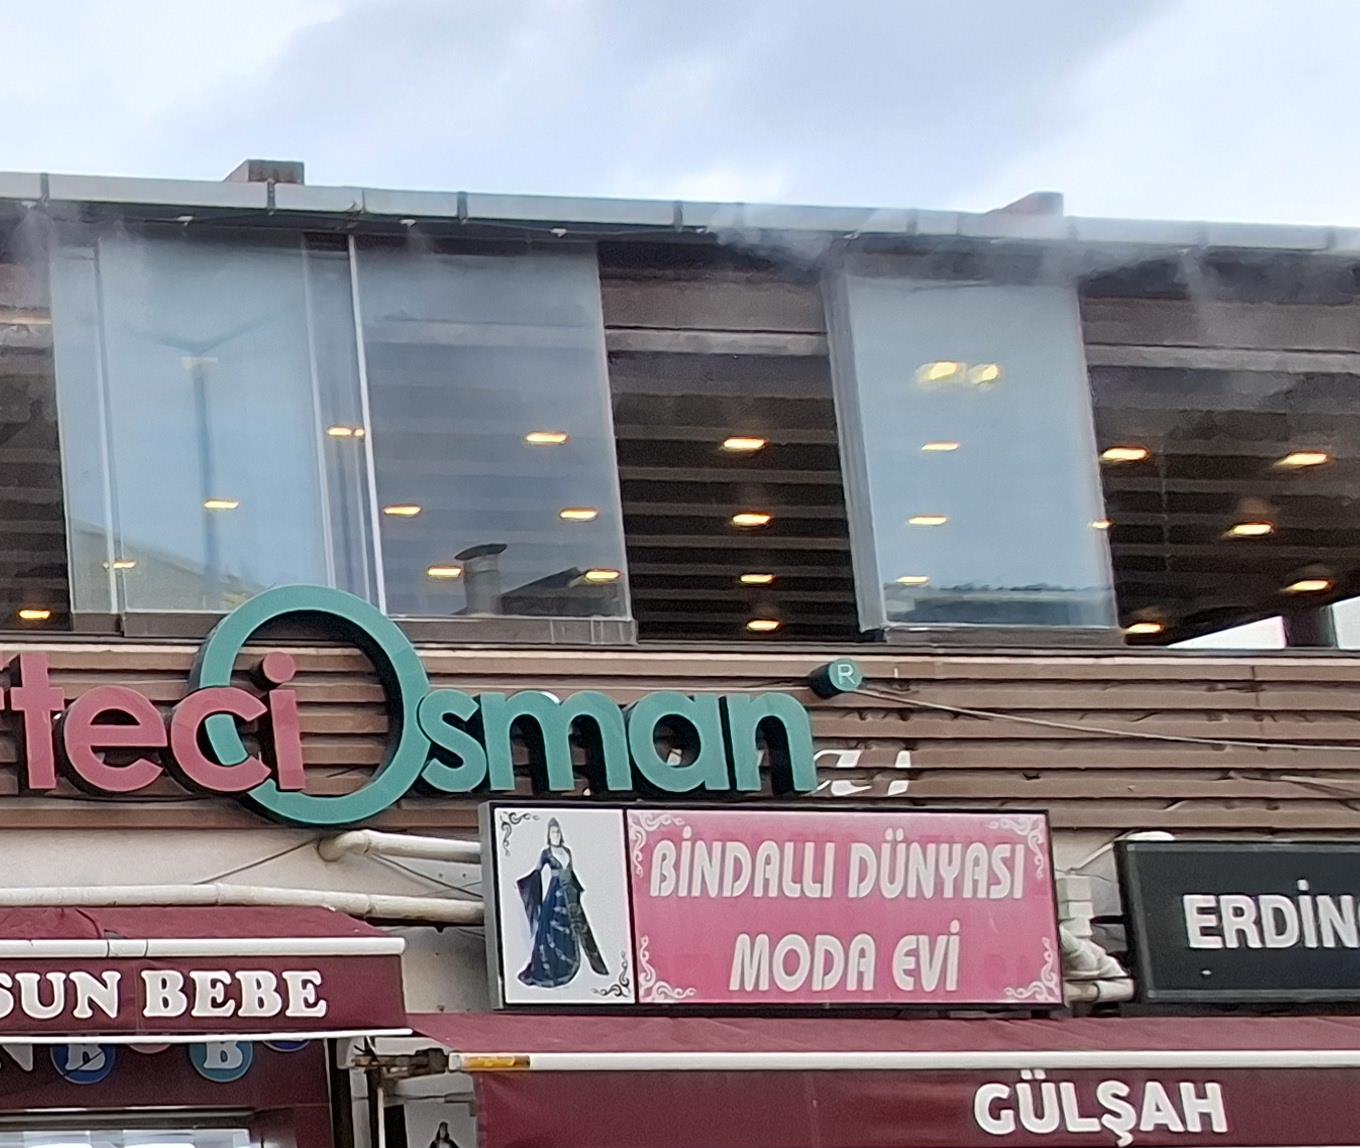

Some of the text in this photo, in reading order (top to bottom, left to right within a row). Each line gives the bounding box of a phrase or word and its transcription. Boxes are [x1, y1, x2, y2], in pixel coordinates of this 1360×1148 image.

[649, 825, 1025, 899] BİNDALLI DÜNYASI
[1182, 878, 1360, 949] ERDİN
[728, 919, 961, 993] MODA EVİ
[140, 969, 328, 1018] BEBE
[973, 1069, 1229, 1147] GÜLŞAH
